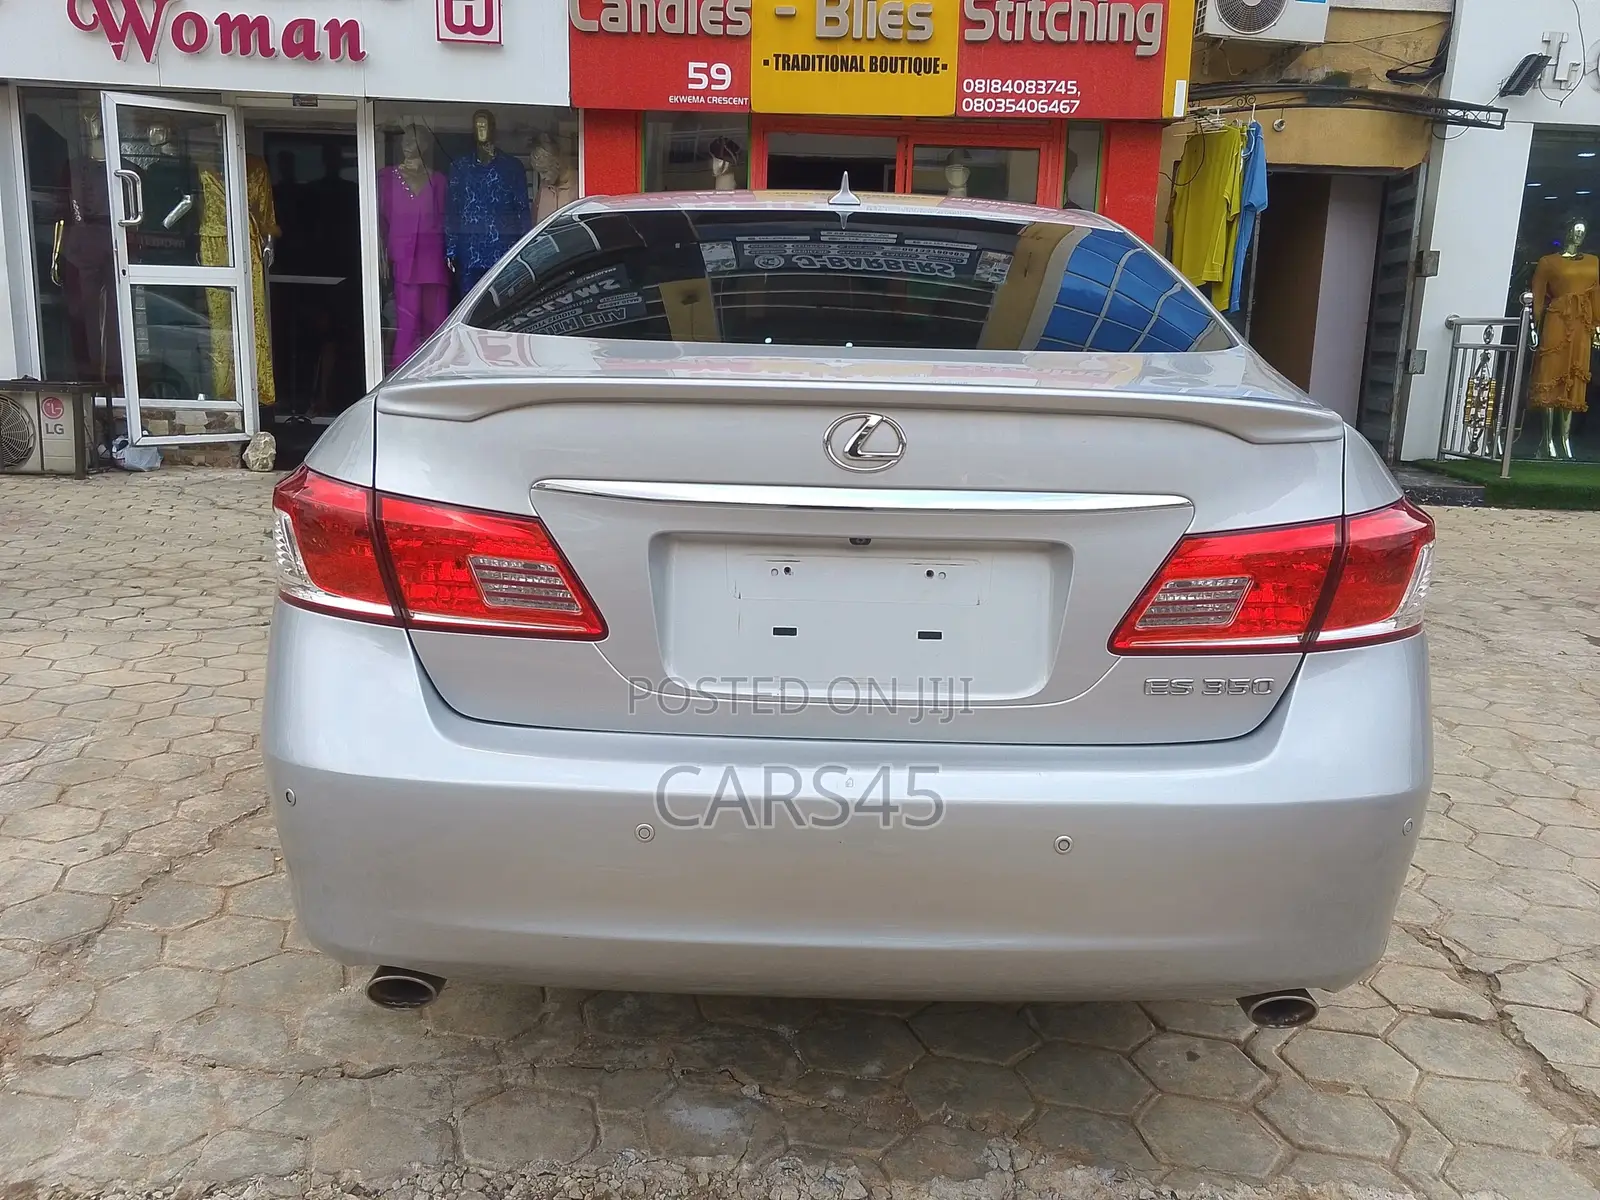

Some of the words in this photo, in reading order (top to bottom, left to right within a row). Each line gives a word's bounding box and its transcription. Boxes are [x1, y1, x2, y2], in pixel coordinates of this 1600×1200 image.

[67, 0, 367, 63] Woman
[569, 0, 752, 36] Candles
[816, 0, 934, 41] Blies
[963, 0, 1164, 56] Stitching
[773, 53, 865, 73] TRADITIONAL
[869, 56, 941, 76] BOUTIQUE
[687, 62, 732, 90] 59
[962, 79, 1081, 97] 08184083745,
[668, 96, 705, 104] EKWEMA
[707, 97, 749, 105] CRESCENT
[962, 98, 1081, 114] 08035406467
[45, 423, 64, 435] LG
[1143, 677, 1194, 696] ES
[1201, 677, 1275, 696] 350
